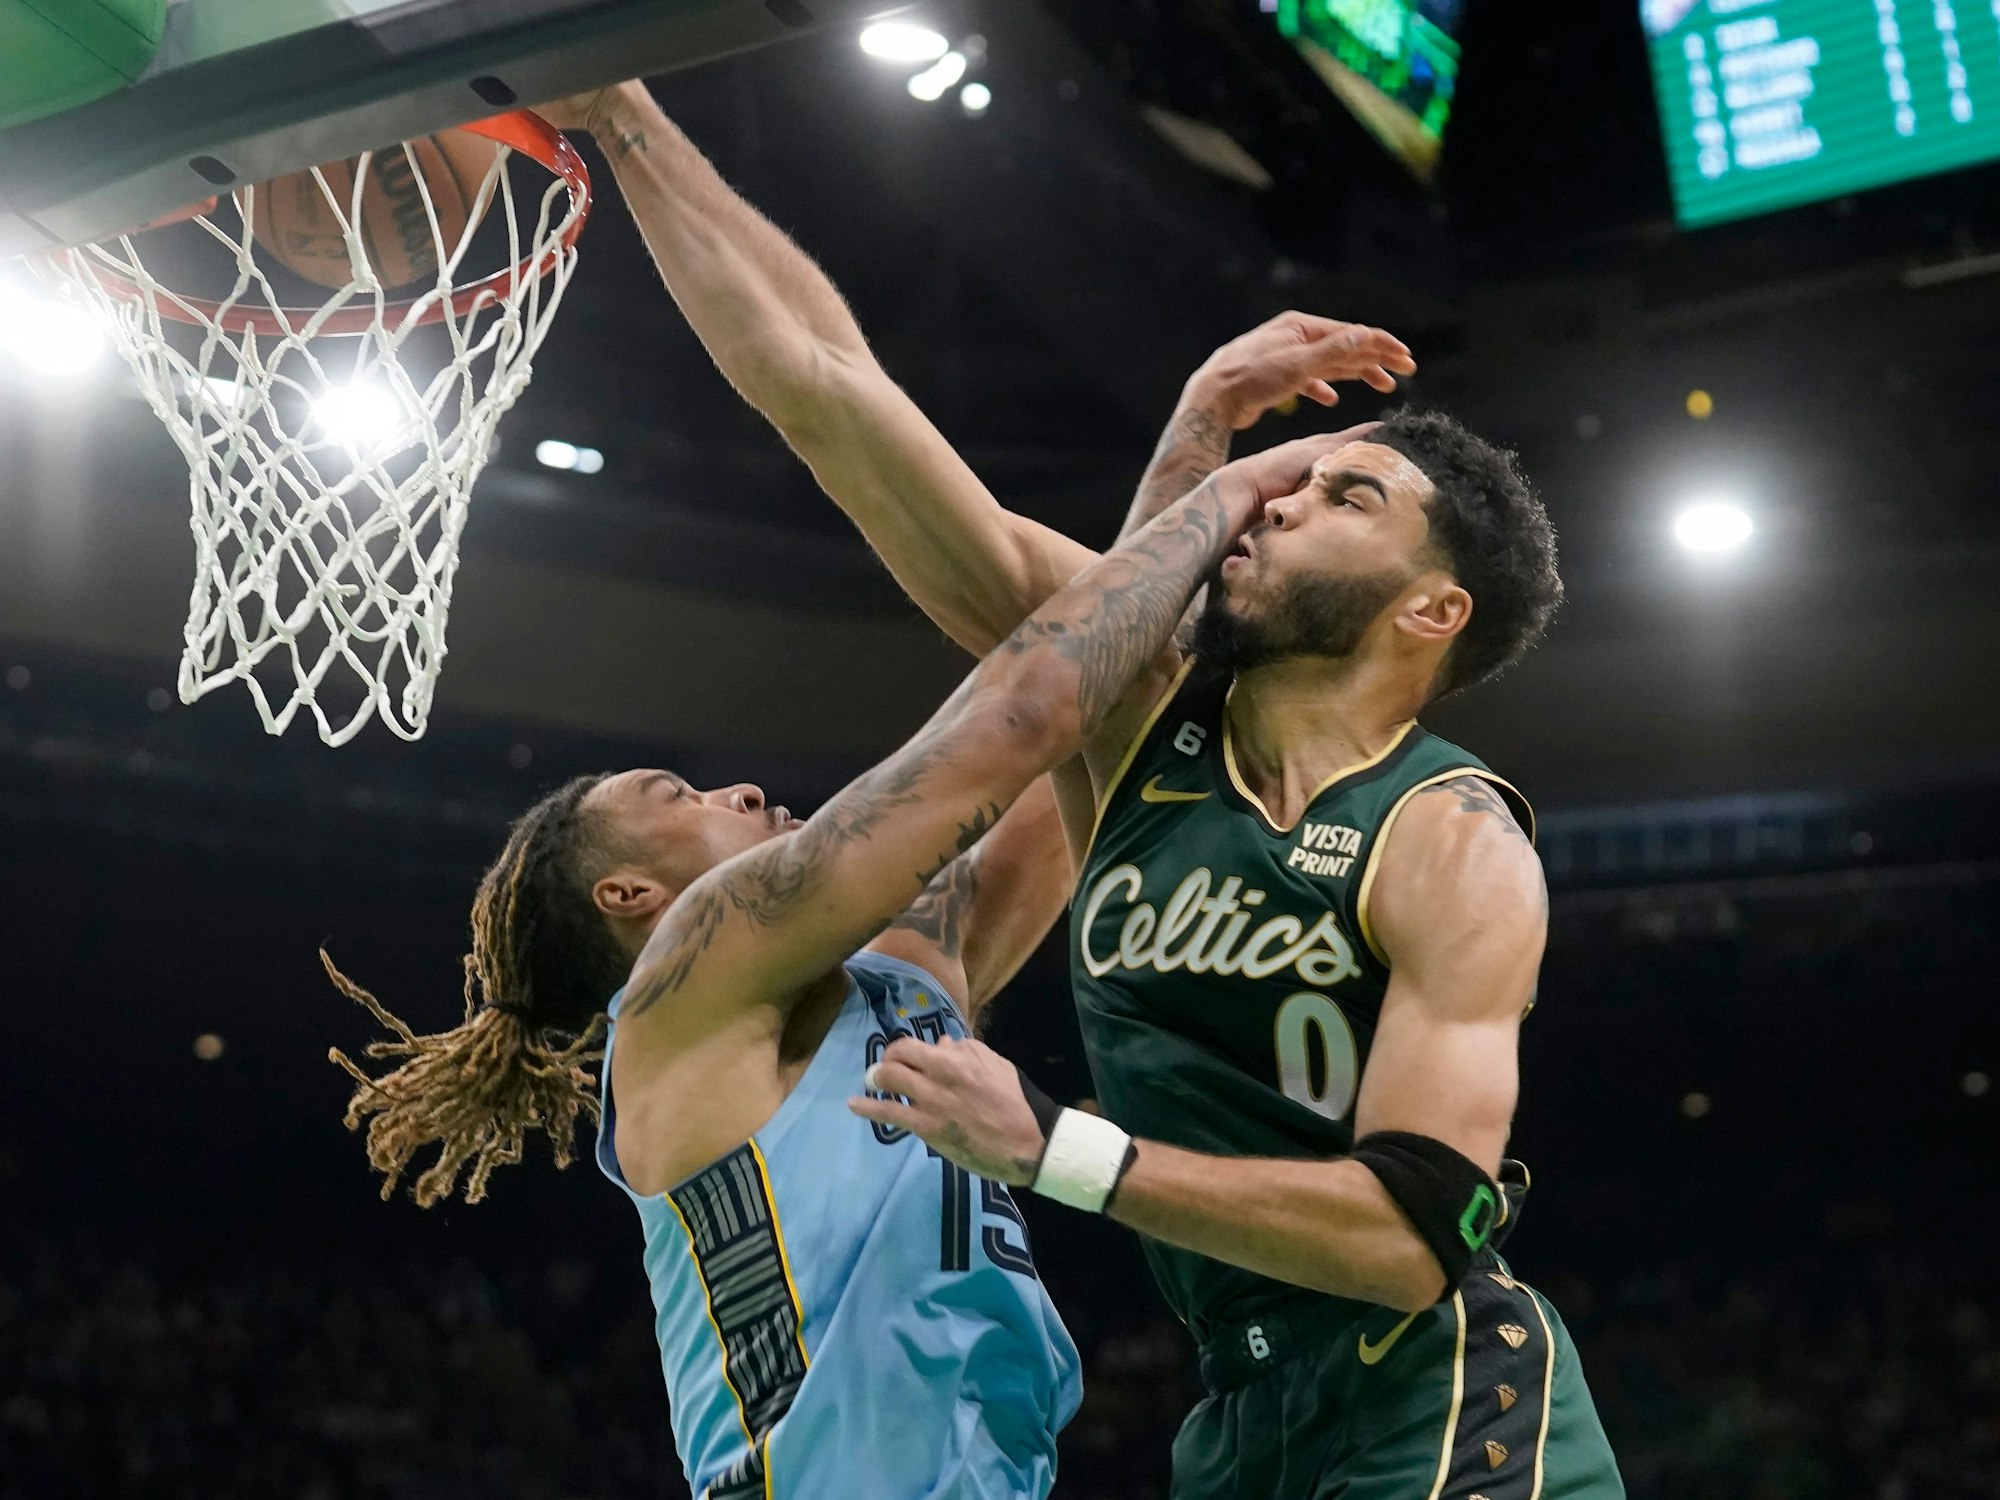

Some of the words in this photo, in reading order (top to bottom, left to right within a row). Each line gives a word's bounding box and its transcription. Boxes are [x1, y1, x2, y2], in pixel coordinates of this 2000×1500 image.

[1173, 720, 1207, 757] 6
[1302, 822, 1363, 858] VISTA
[1287, 846, 1355, 878] PRINT
[1080, 864, 1363, 987] Celtics
[1274, 991, 1360, 1121] 0
[1247, 1325, 1271, 1360] 6
